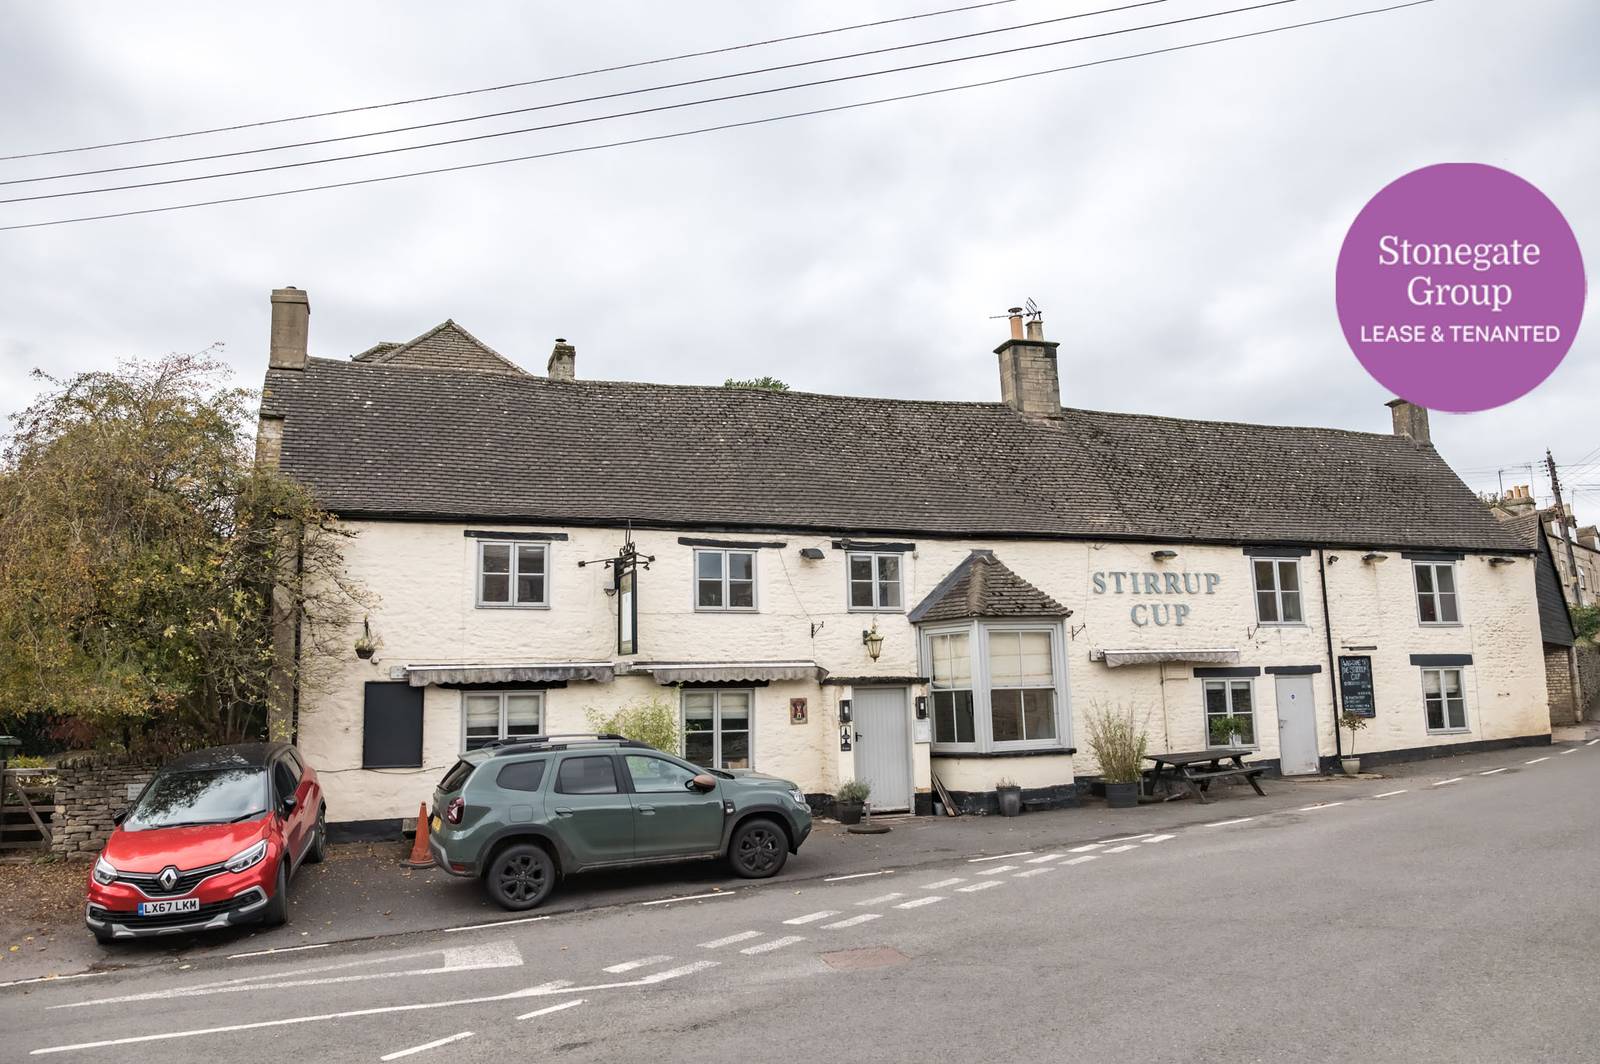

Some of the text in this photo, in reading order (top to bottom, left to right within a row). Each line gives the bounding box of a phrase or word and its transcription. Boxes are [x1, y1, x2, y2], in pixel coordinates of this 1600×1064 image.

[1092, 571, 1221, 595] STIRRUP
[1130, 603, 1190, 627] CUP
[144, 900, 196, 913] LX67 LKM
